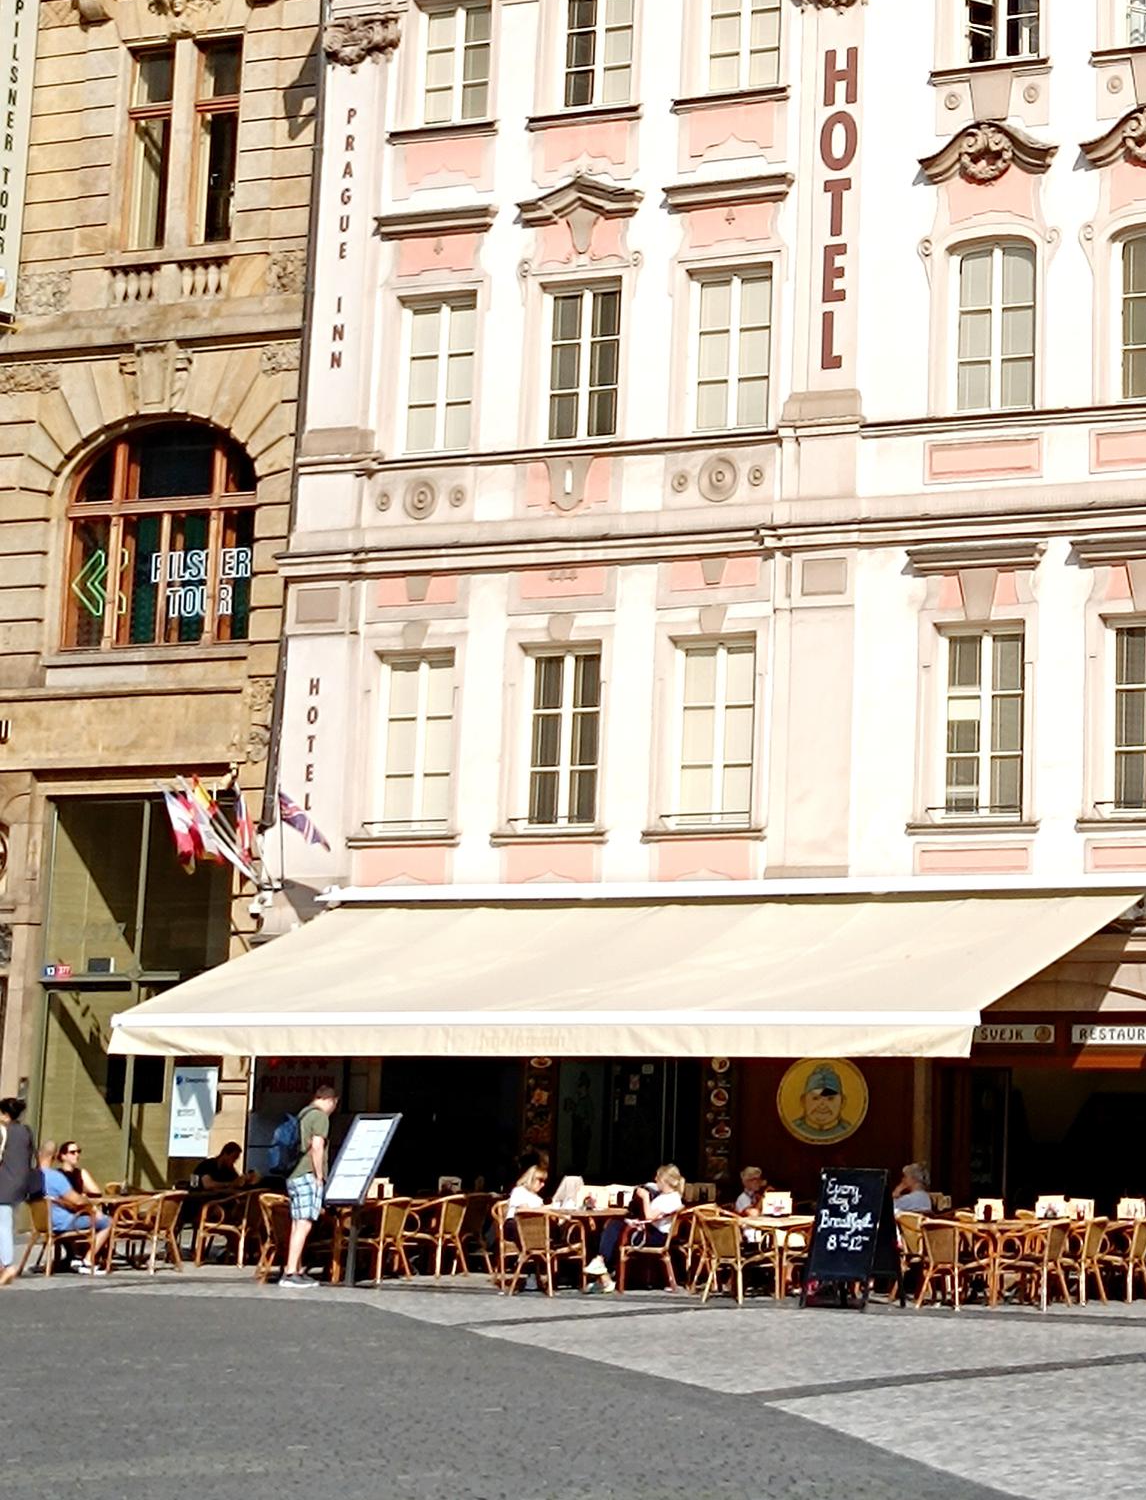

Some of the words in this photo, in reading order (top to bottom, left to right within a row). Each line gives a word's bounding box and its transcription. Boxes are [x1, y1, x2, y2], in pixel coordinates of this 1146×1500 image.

[0, 167, 11, 255] TOUR
[338, 108, 357, 260] PRAGUE
[820, 47, 858, 370] HOTEL
[329, 296, 345, 370] INN
[304, 677, 320, 811] HOTEL
[261, 1076, 310, 1093] PRAGUE
